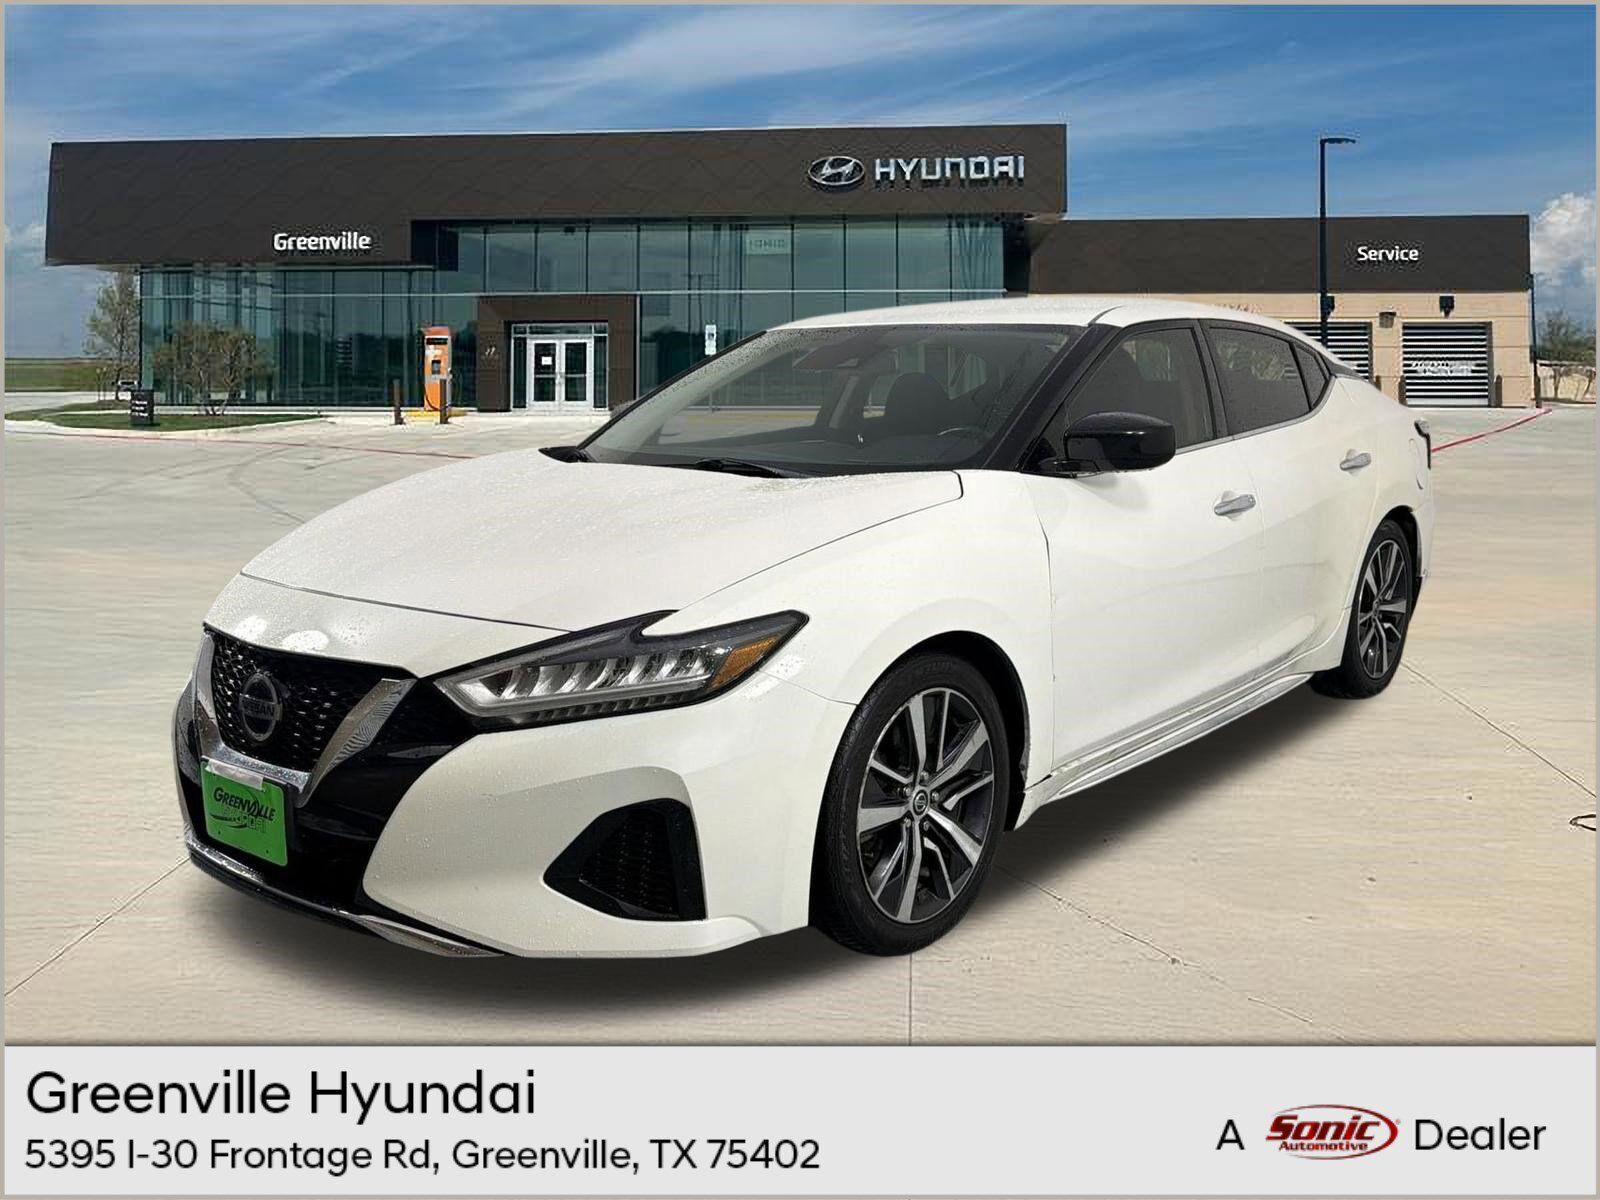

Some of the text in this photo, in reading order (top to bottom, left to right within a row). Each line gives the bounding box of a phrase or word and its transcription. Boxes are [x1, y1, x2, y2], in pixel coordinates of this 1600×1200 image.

[875, 155, 1025, 181] HYUNDAI
[273, 231, 372, 251] Greenville
[1357, 245, 1419, 261] Service
